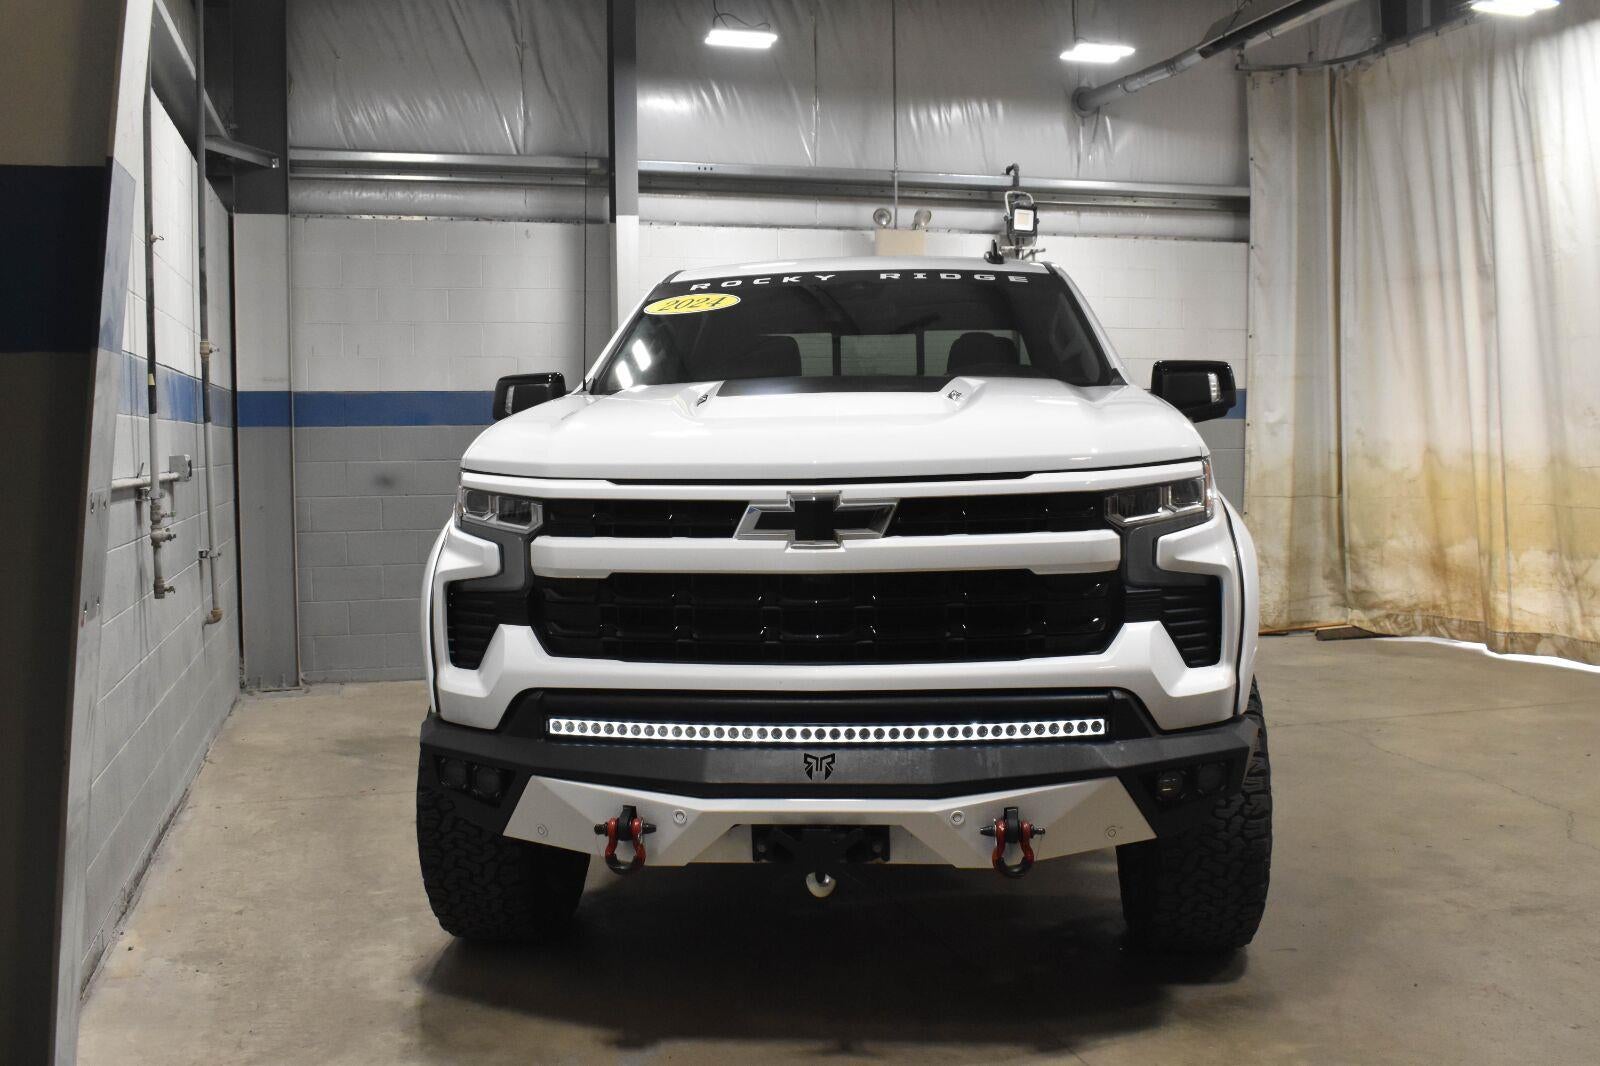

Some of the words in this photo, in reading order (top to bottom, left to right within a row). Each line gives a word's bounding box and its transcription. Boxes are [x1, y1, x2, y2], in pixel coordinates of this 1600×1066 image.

[690, 274, 836, 291] ROCKY
[880, 272, 1029, 283] RIDGE
[657, 296, 727, 312] 2024
